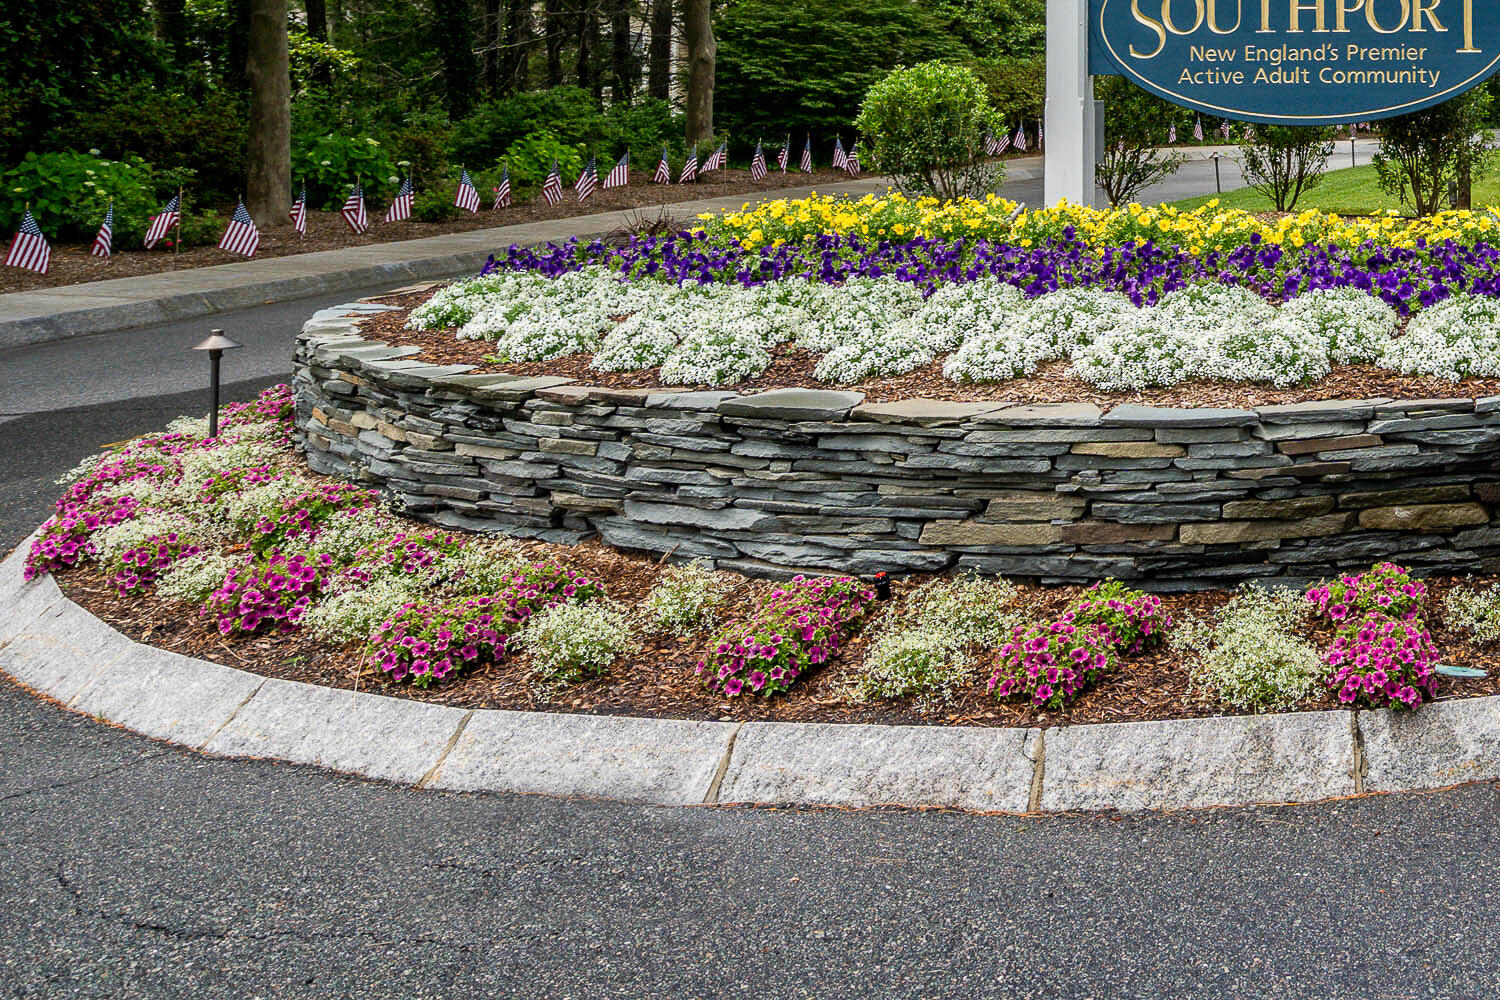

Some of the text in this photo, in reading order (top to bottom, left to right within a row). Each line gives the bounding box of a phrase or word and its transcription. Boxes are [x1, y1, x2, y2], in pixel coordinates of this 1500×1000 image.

[1189, 43, 1428, 67] New England's Premier
[1177, 66, 1441, 89] Active Adult Community
